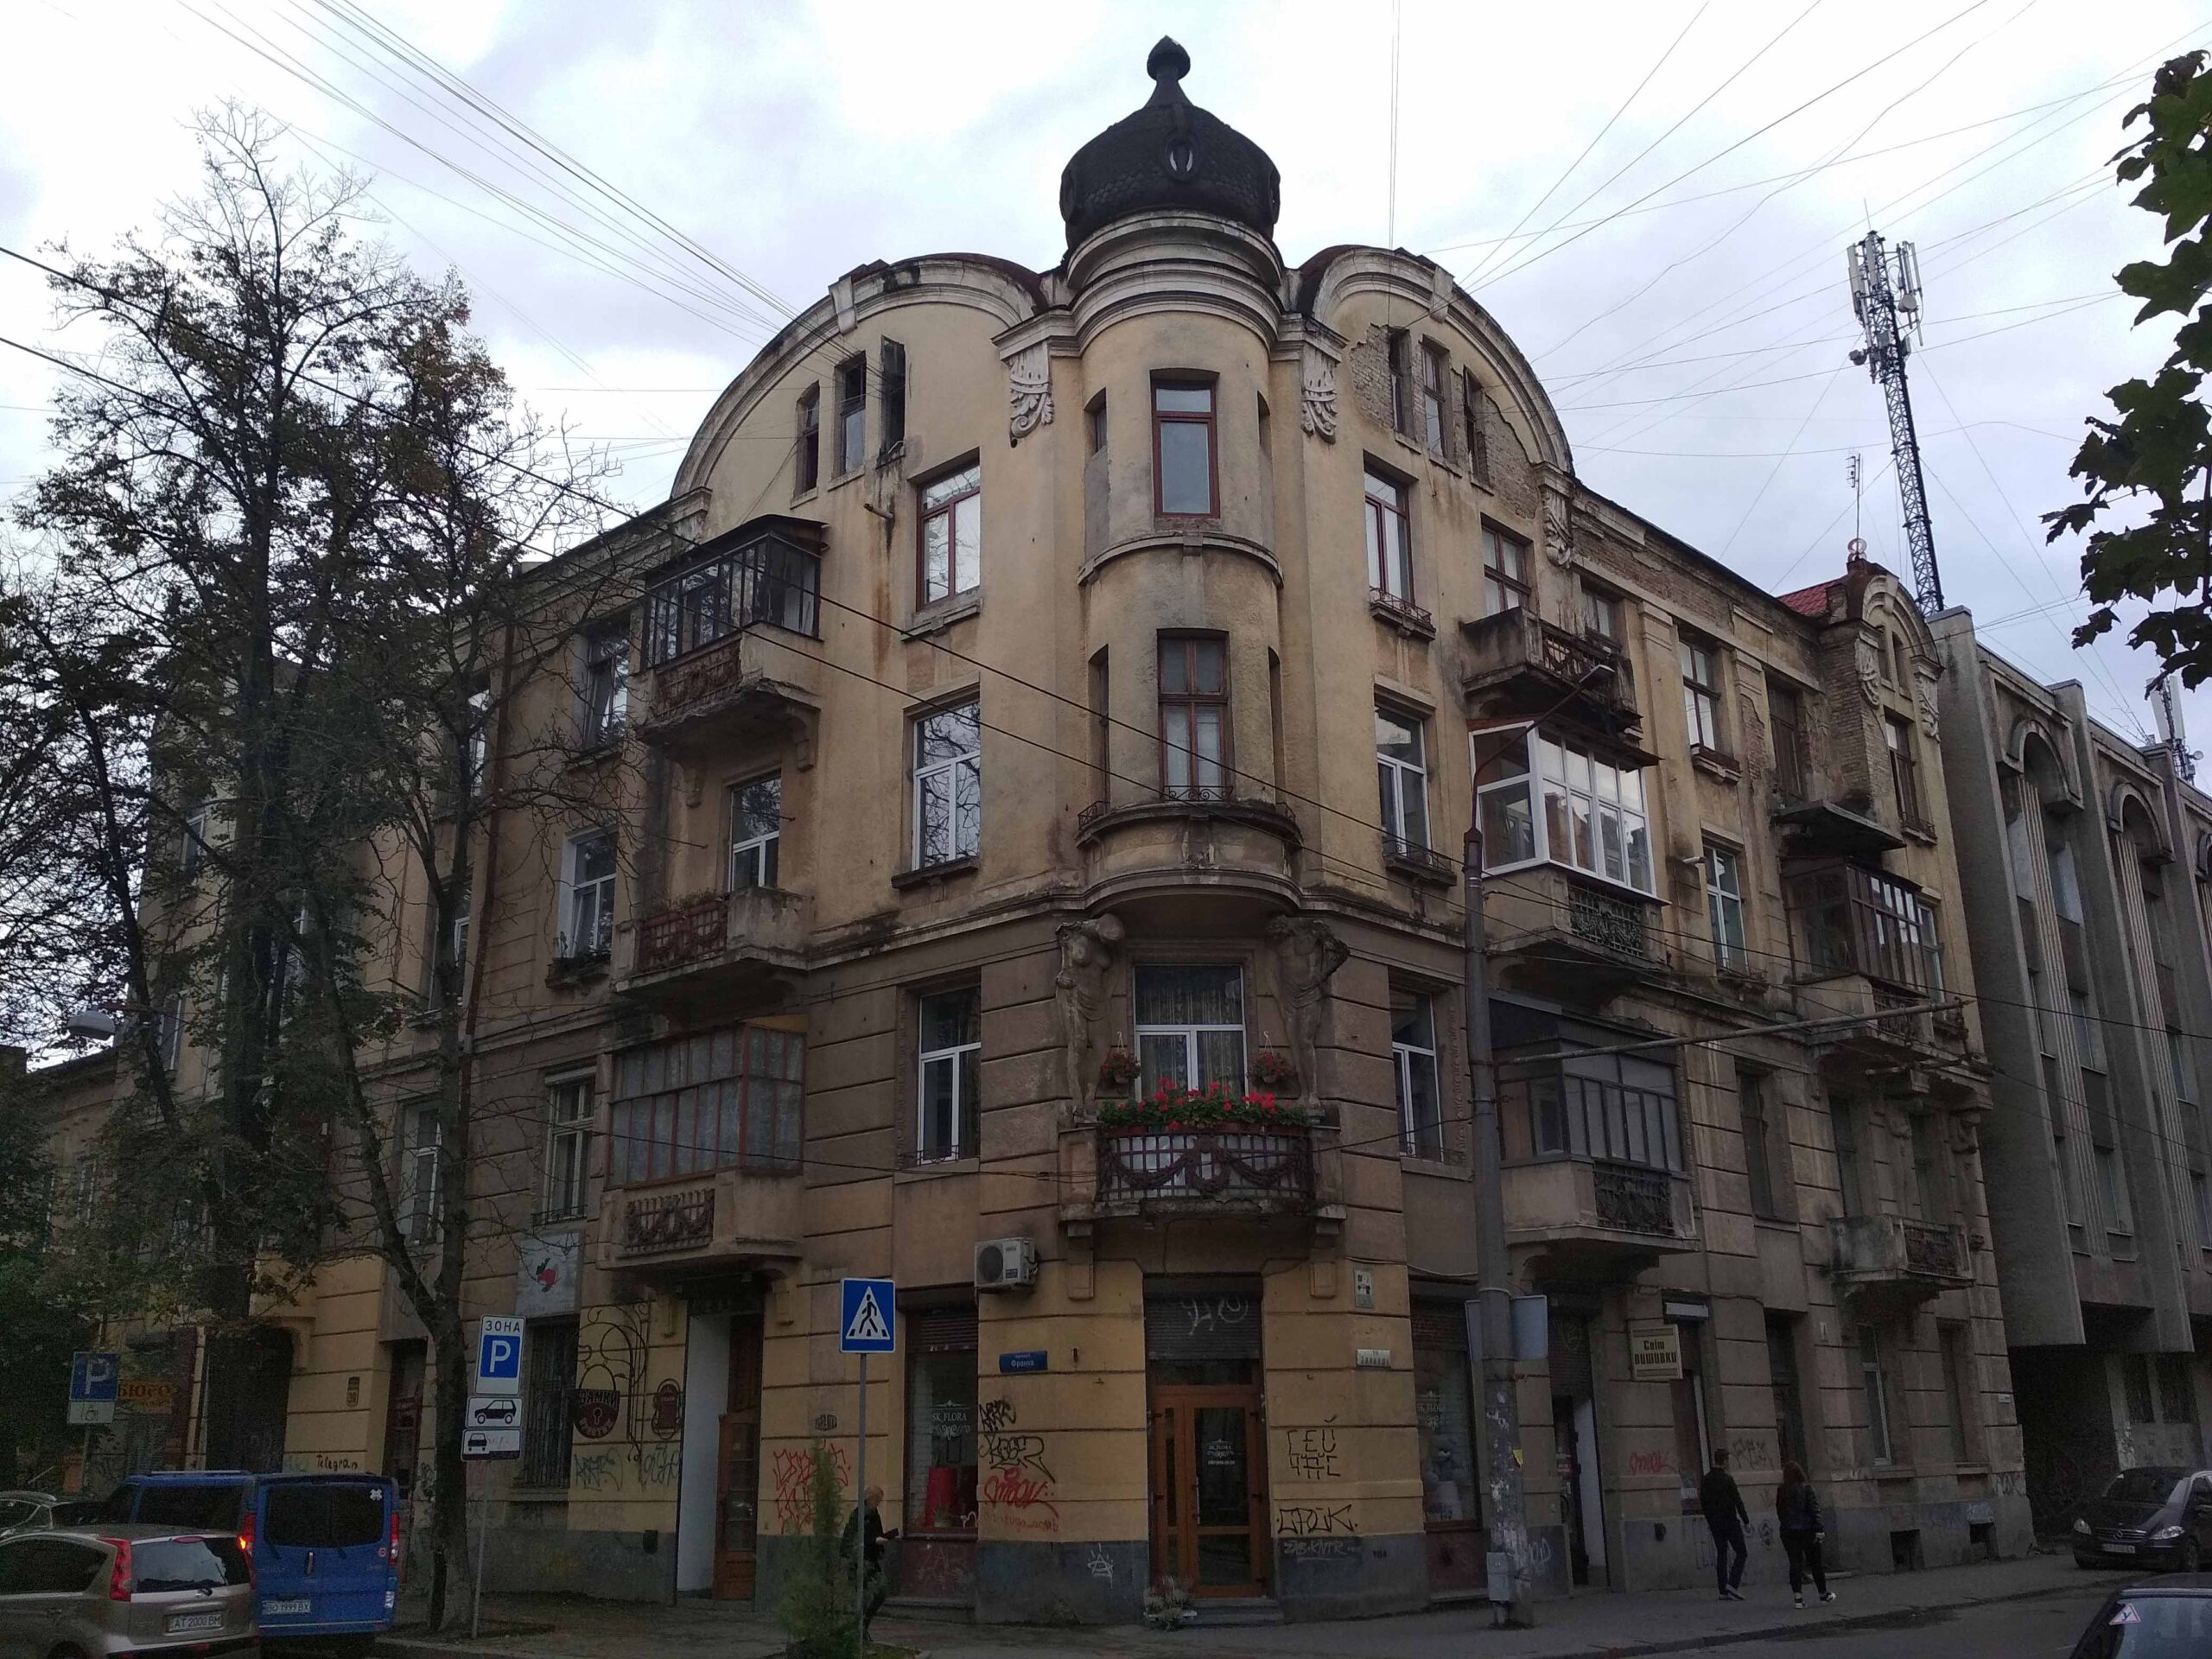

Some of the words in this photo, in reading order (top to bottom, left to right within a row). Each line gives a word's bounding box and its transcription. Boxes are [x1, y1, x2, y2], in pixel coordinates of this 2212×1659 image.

[486, 1320, 520, 1332] ЗОНА
[489, 1339, 512, 1373] P
[85, 1358, 110, 1395] P
[580, 1390, 619, 1411] ЗАМКИ
[931, 1413, 943, 1422] SK
[944, 1412, 968, 1422] FLORA
[188, 1616, 207, 1627] 2000
